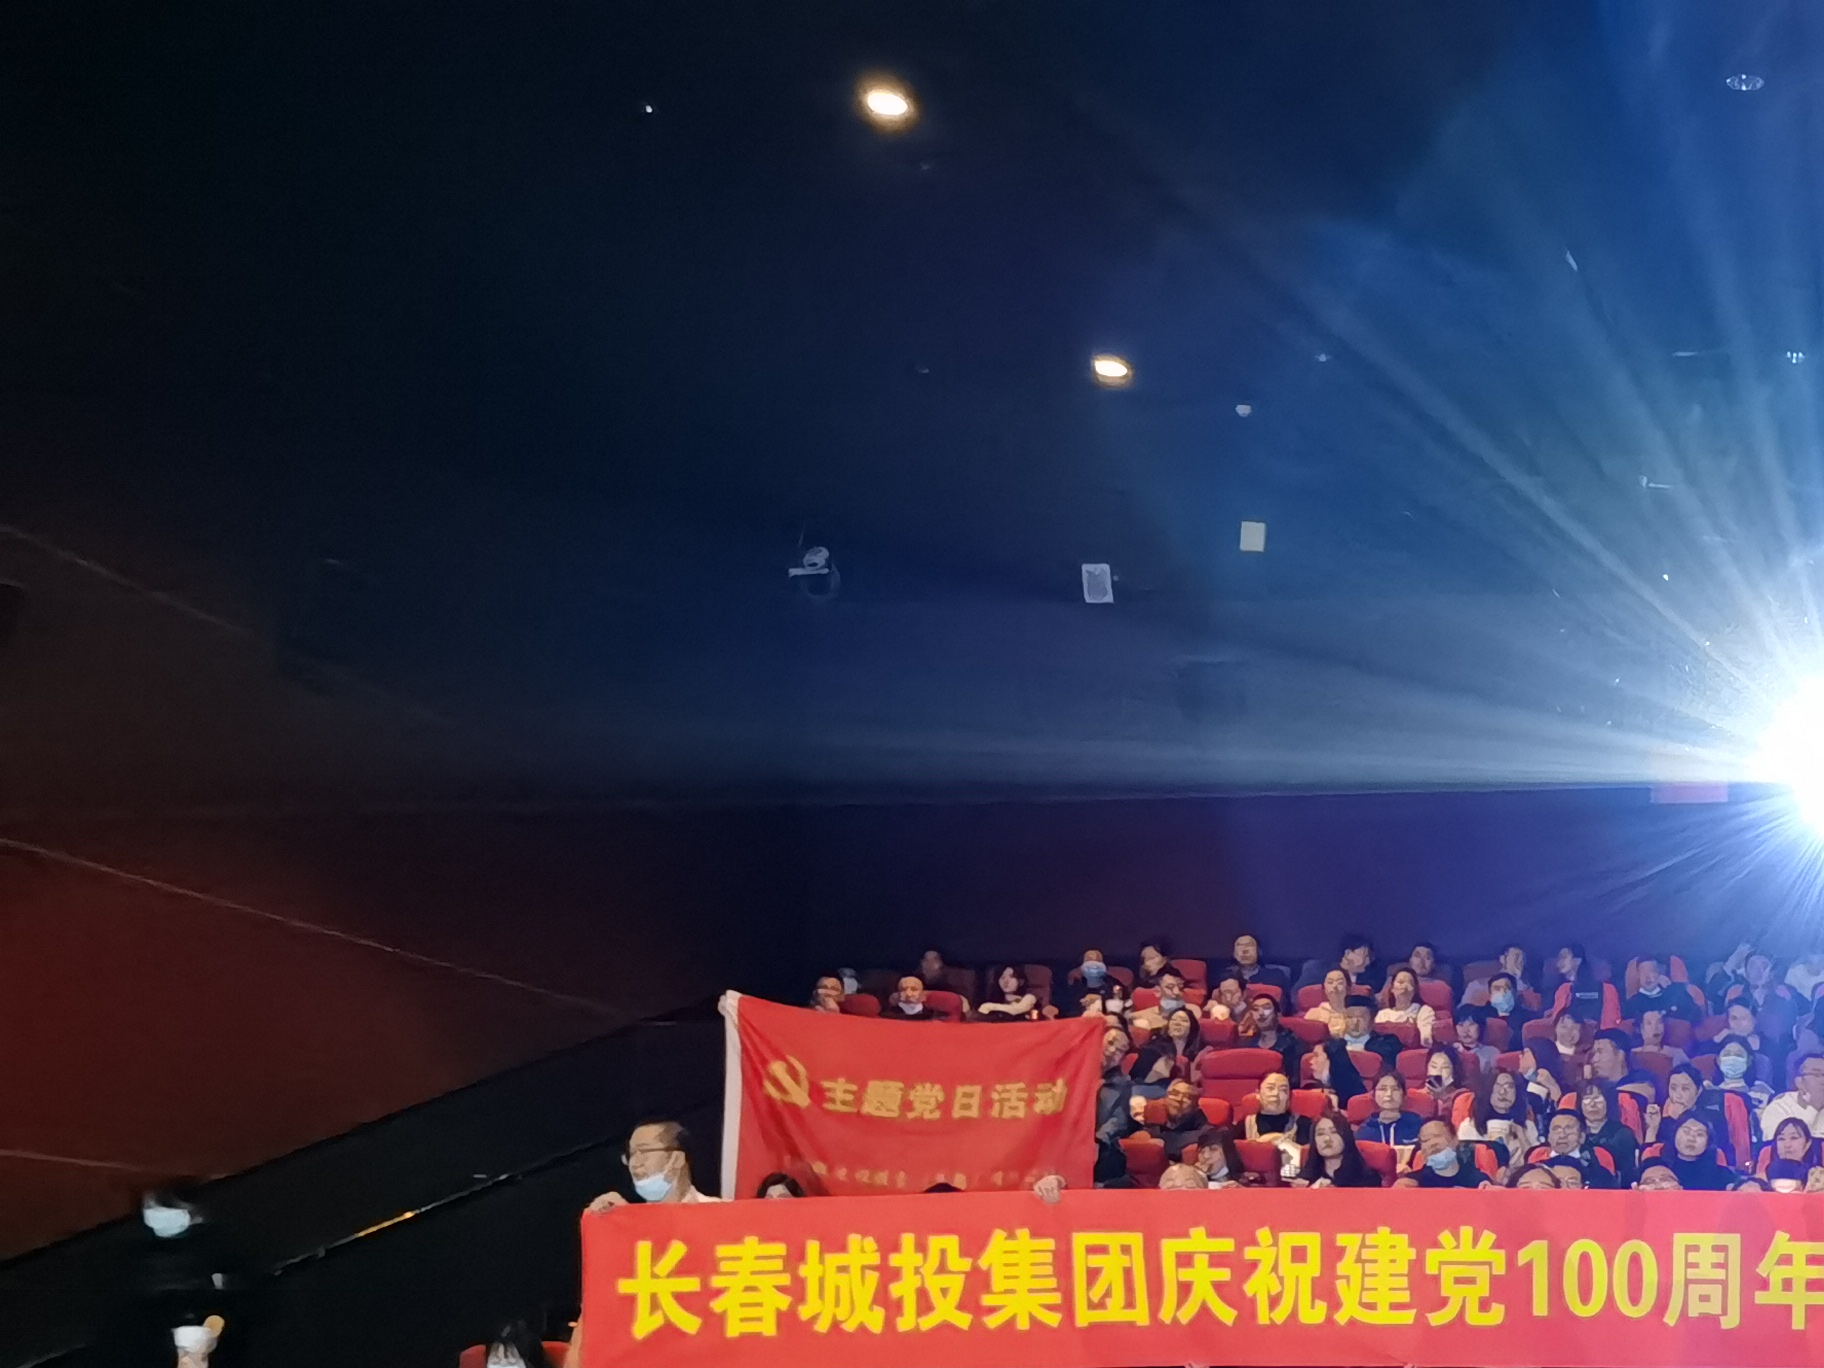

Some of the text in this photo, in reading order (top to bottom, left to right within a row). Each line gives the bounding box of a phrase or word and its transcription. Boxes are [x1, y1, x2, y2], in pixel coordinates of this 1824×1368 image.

[821, 1077, 1068, 1120] 主题党日活动
